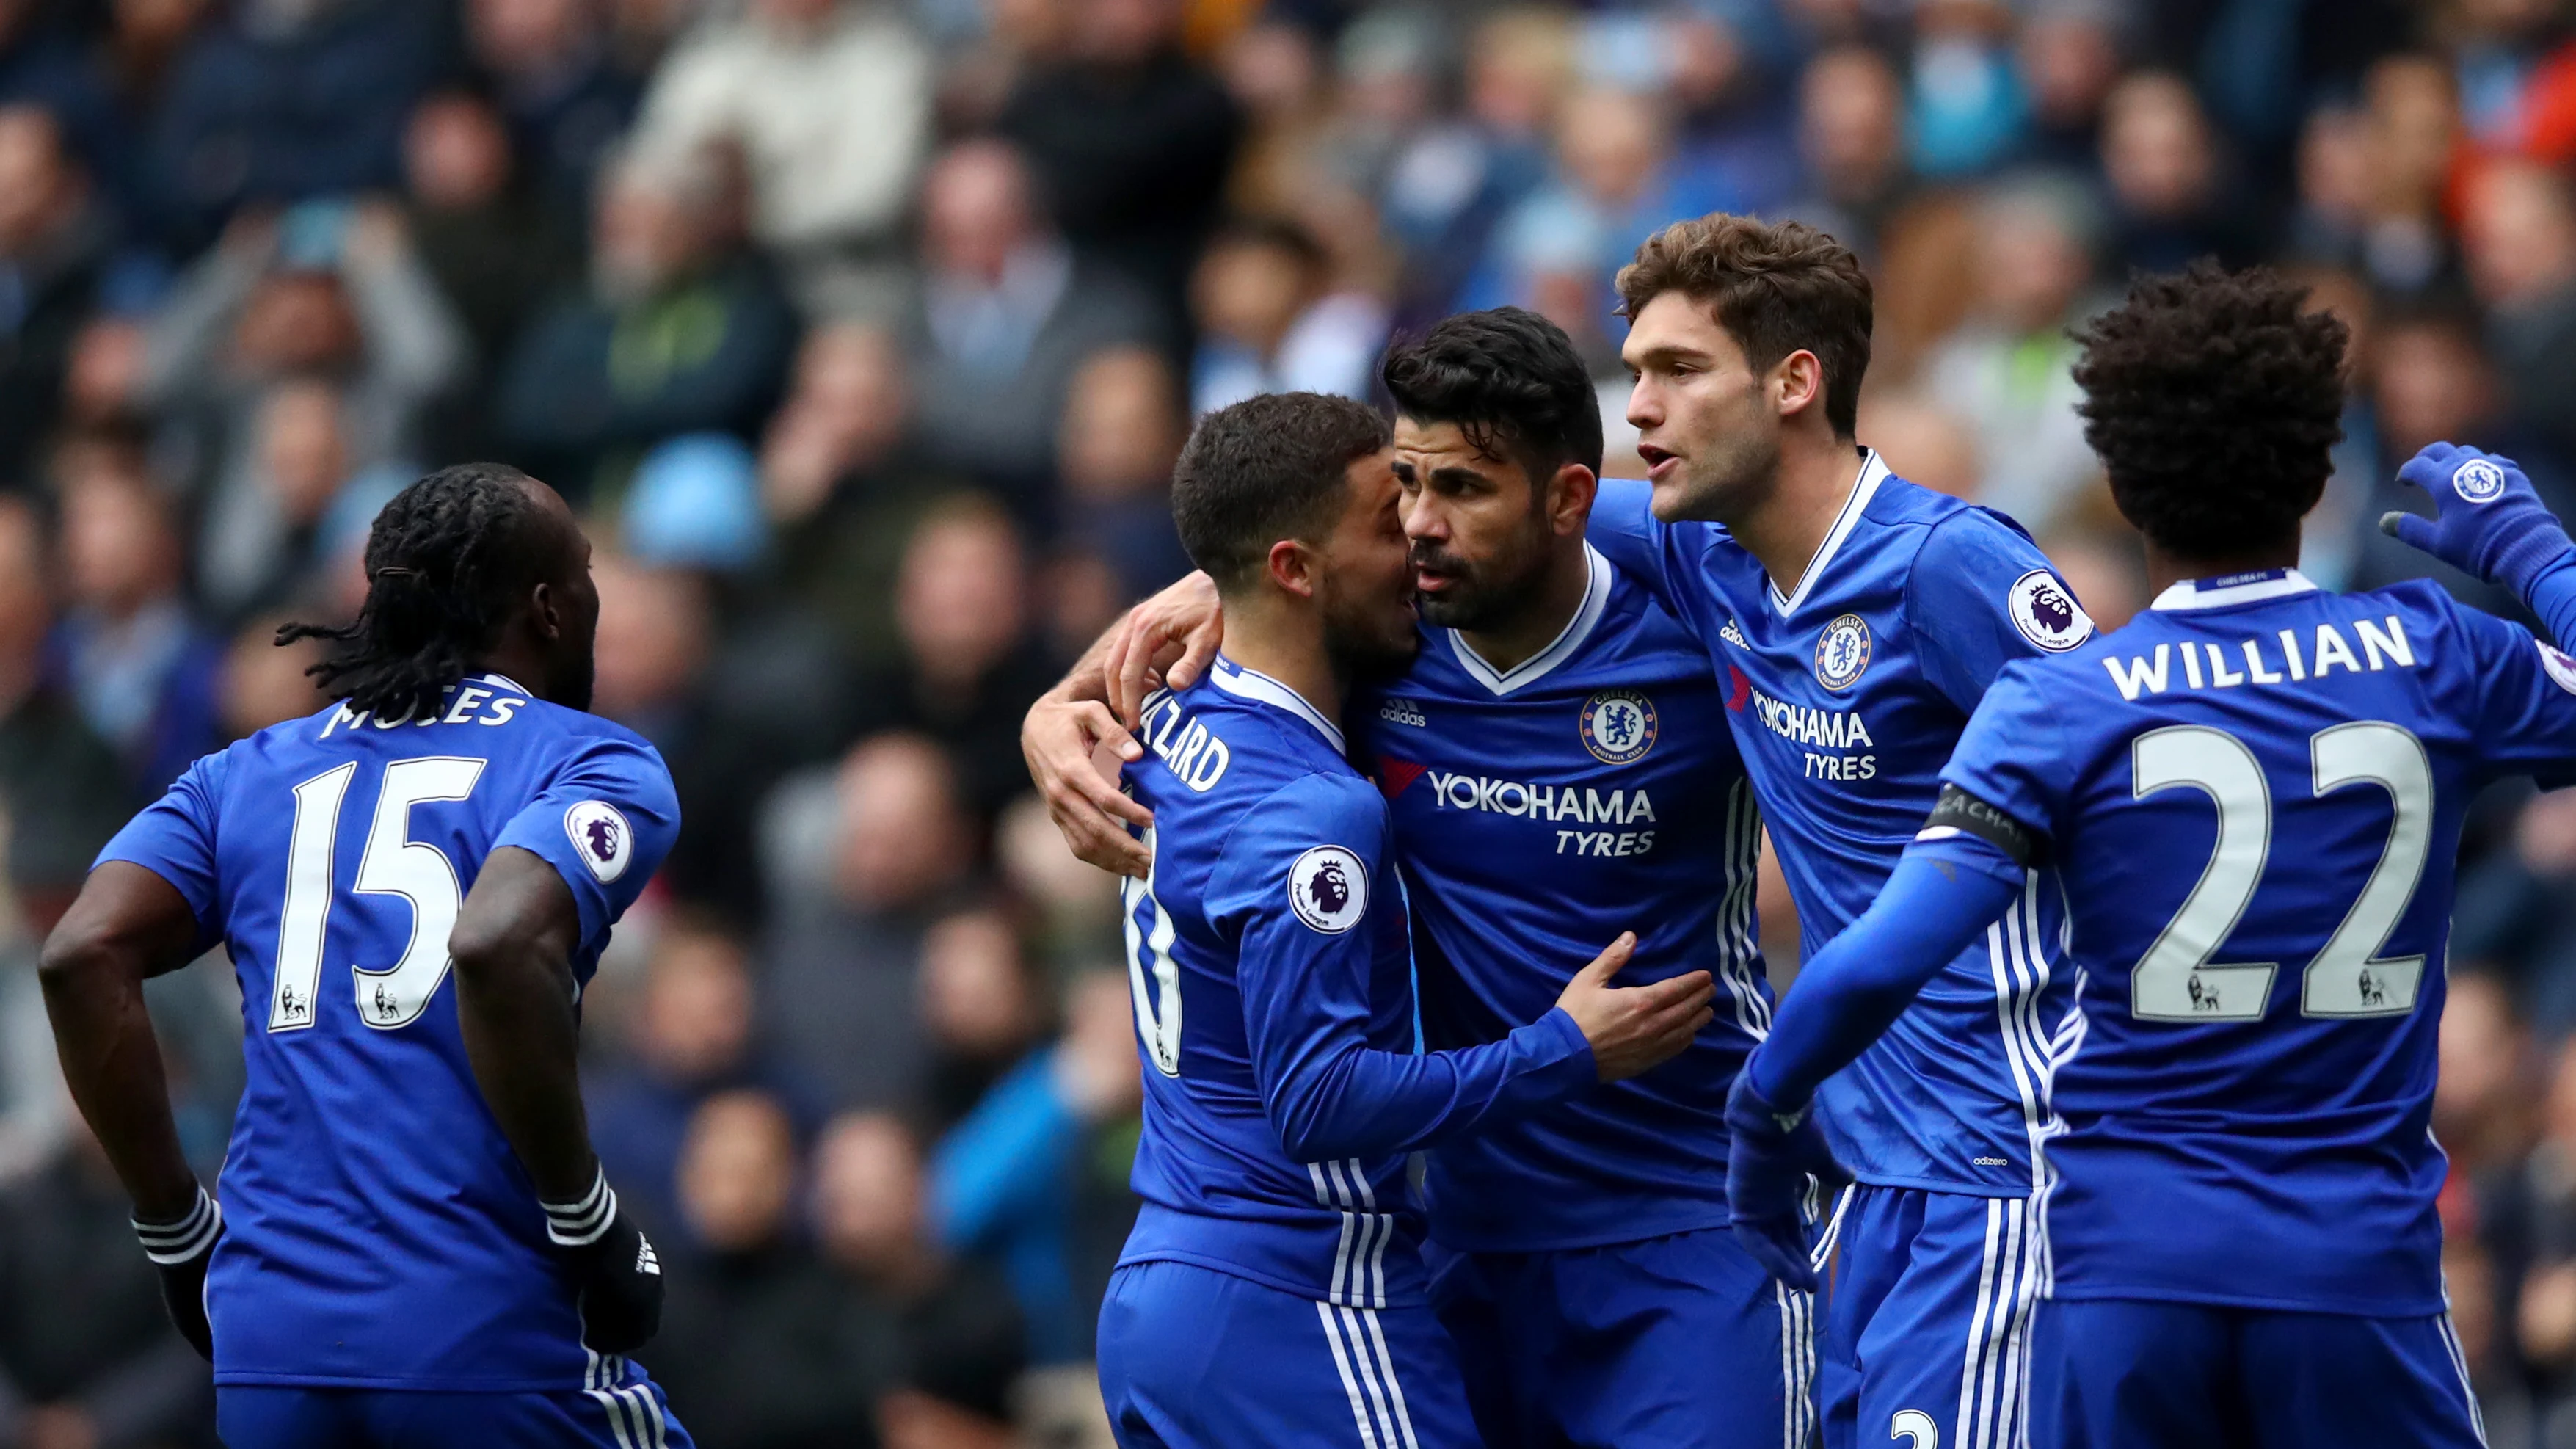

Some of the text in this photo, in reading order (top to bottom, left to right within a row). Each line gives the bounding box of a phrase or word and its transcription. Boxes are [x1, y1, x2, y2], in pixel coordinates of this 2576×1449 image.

[1830, 617, 1863, 633] CHELSEA
[2022, 618, 2070, 646] Premier League
[2102, 615, 2415, 702] WILLIAN
[1594, 689, 1643, 707] CHELSEA
[1380, 707, 1426, 727] adidas
[1750, 686, 1874, 748] YOKOHAMA
[1593, 745, 1644, 760] FOOTBALL CLUB
[1805, 752, 1876, 780] TYRES
[1427, 770, 1656, 824] YOKOHAMA
[1556, 829, 1656, 857] TYRES
[2132, 719, 2435, 1022] 22
[267, 755, 488, 1033] 15
[1295, 882, 1330, 926] Premier League
[1973, 1156, 2008, 1166] adizero
